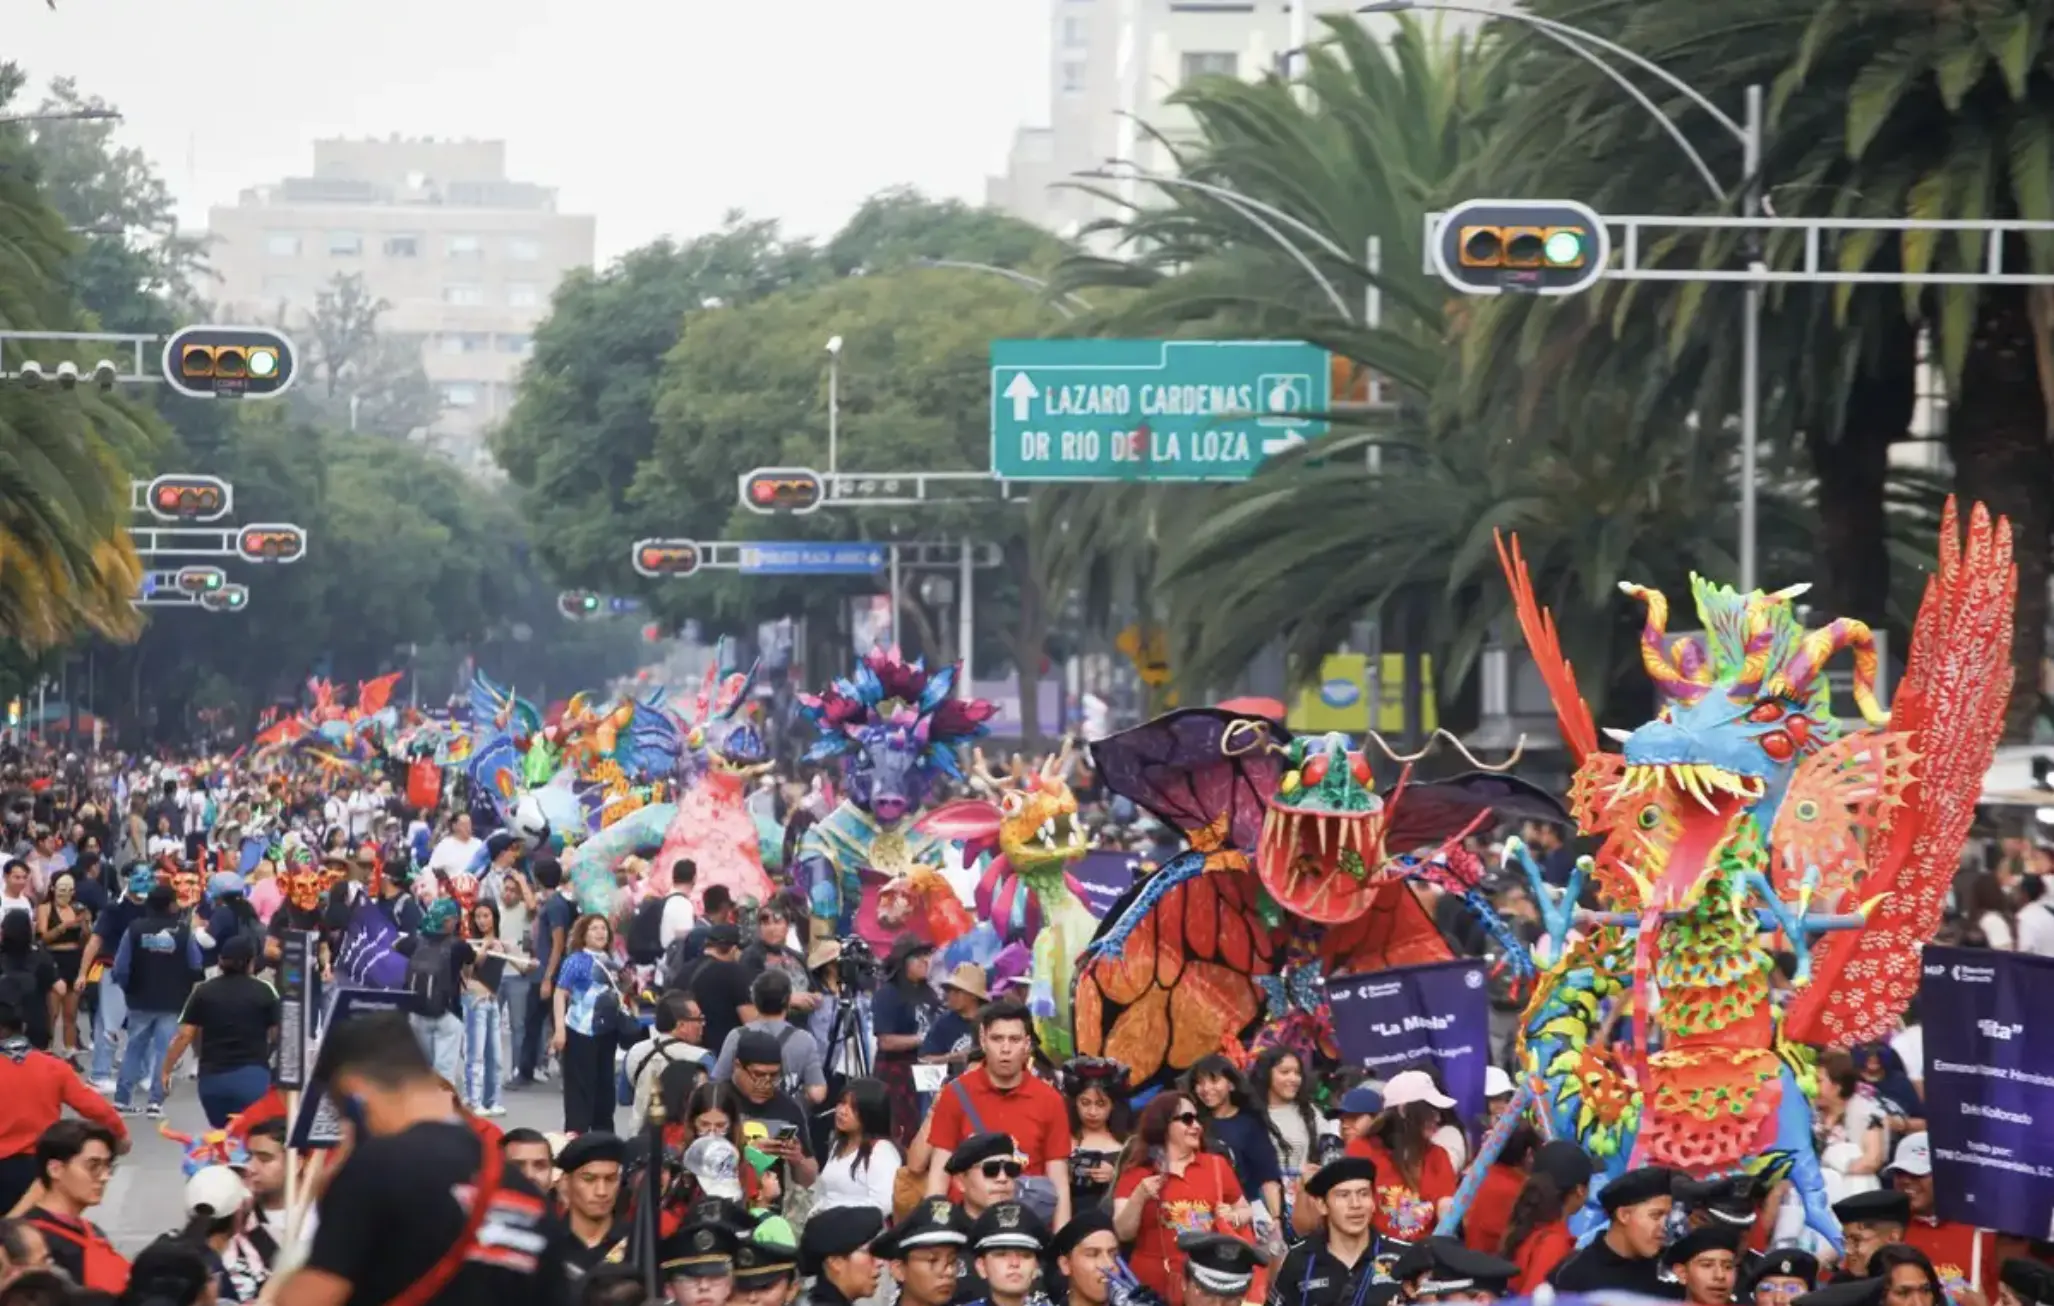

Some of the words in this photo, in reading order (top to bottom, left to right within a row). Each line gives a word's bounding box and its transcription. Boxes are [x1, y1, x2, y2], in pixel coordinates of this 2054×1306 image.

[1045, 384, 1130, 415] LAZARO
[1140, 384, 1252, 415] CARDENAS
[1021, 430, 1050, 461] DR
[1061, 430, 1100, 461] RIO
[1111, 431, 1141, 461] DE
[1150, 431, 1181, 461] LA
[1191, 430, 1250, 461] LOZA
